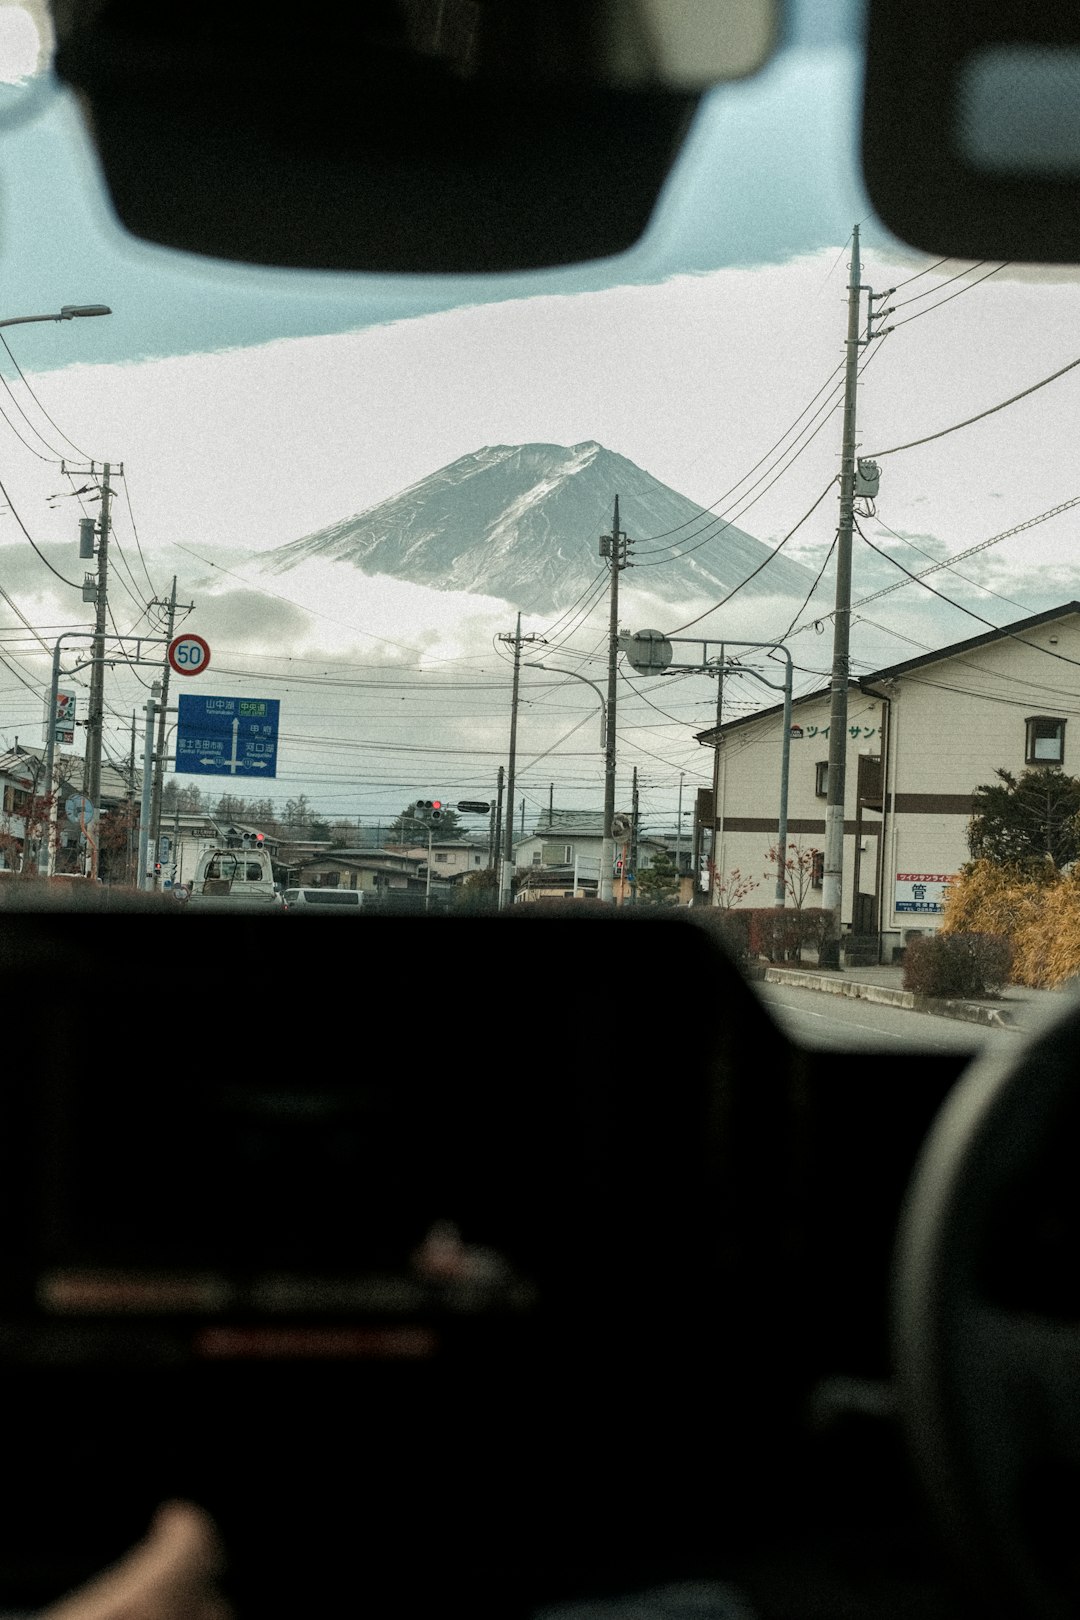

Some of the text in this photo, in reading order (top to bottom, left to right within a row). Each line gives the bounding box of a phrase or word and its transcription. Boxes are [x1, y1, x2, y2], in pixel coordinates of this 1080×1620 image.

[177, 645, 201, 664] 50
[206, 700, 235, 710] 山中湖
[240, 703, 266, 712] 中央道
[246, 742, 275, 753] 河口湖
